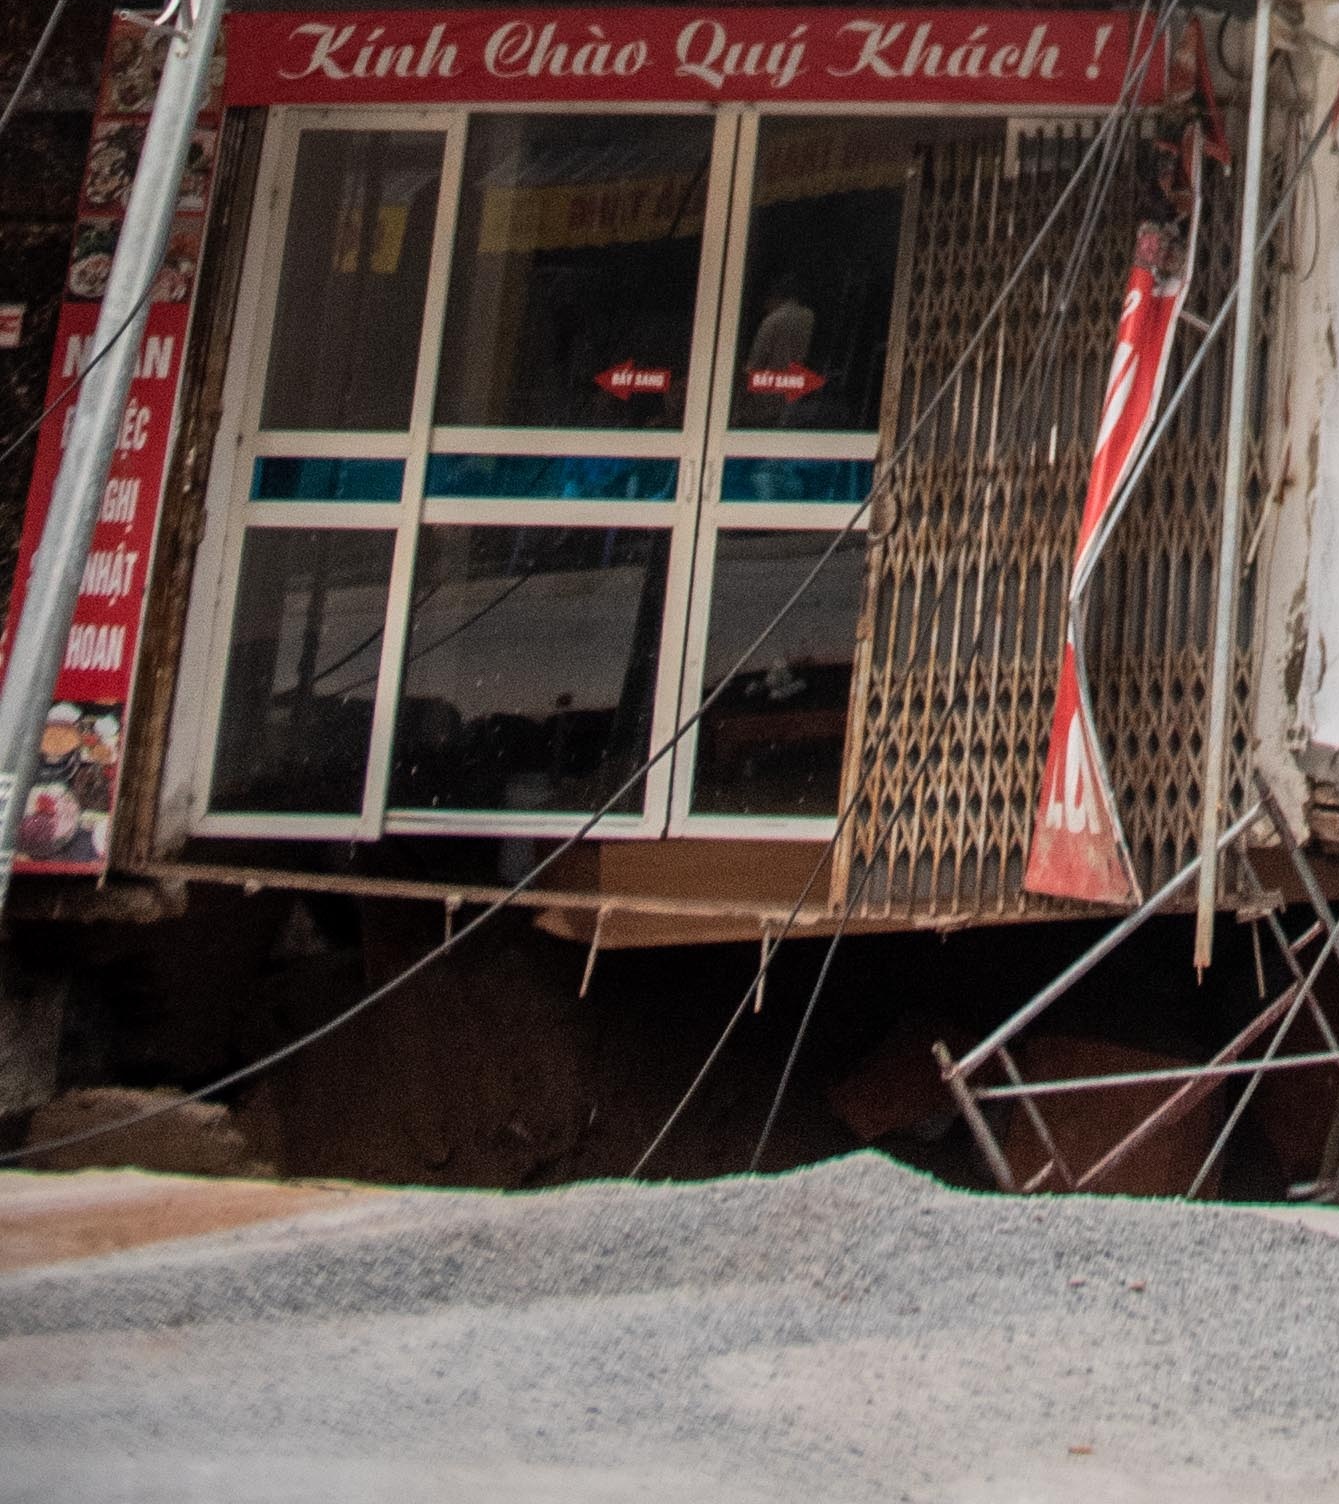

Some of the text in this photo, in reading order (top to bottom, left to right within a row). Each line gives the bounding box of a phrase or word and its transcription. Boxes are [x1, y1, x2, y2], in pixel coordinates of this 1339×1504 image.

[278, 19, 1111, 89] Kính Chào Quý Khách !
